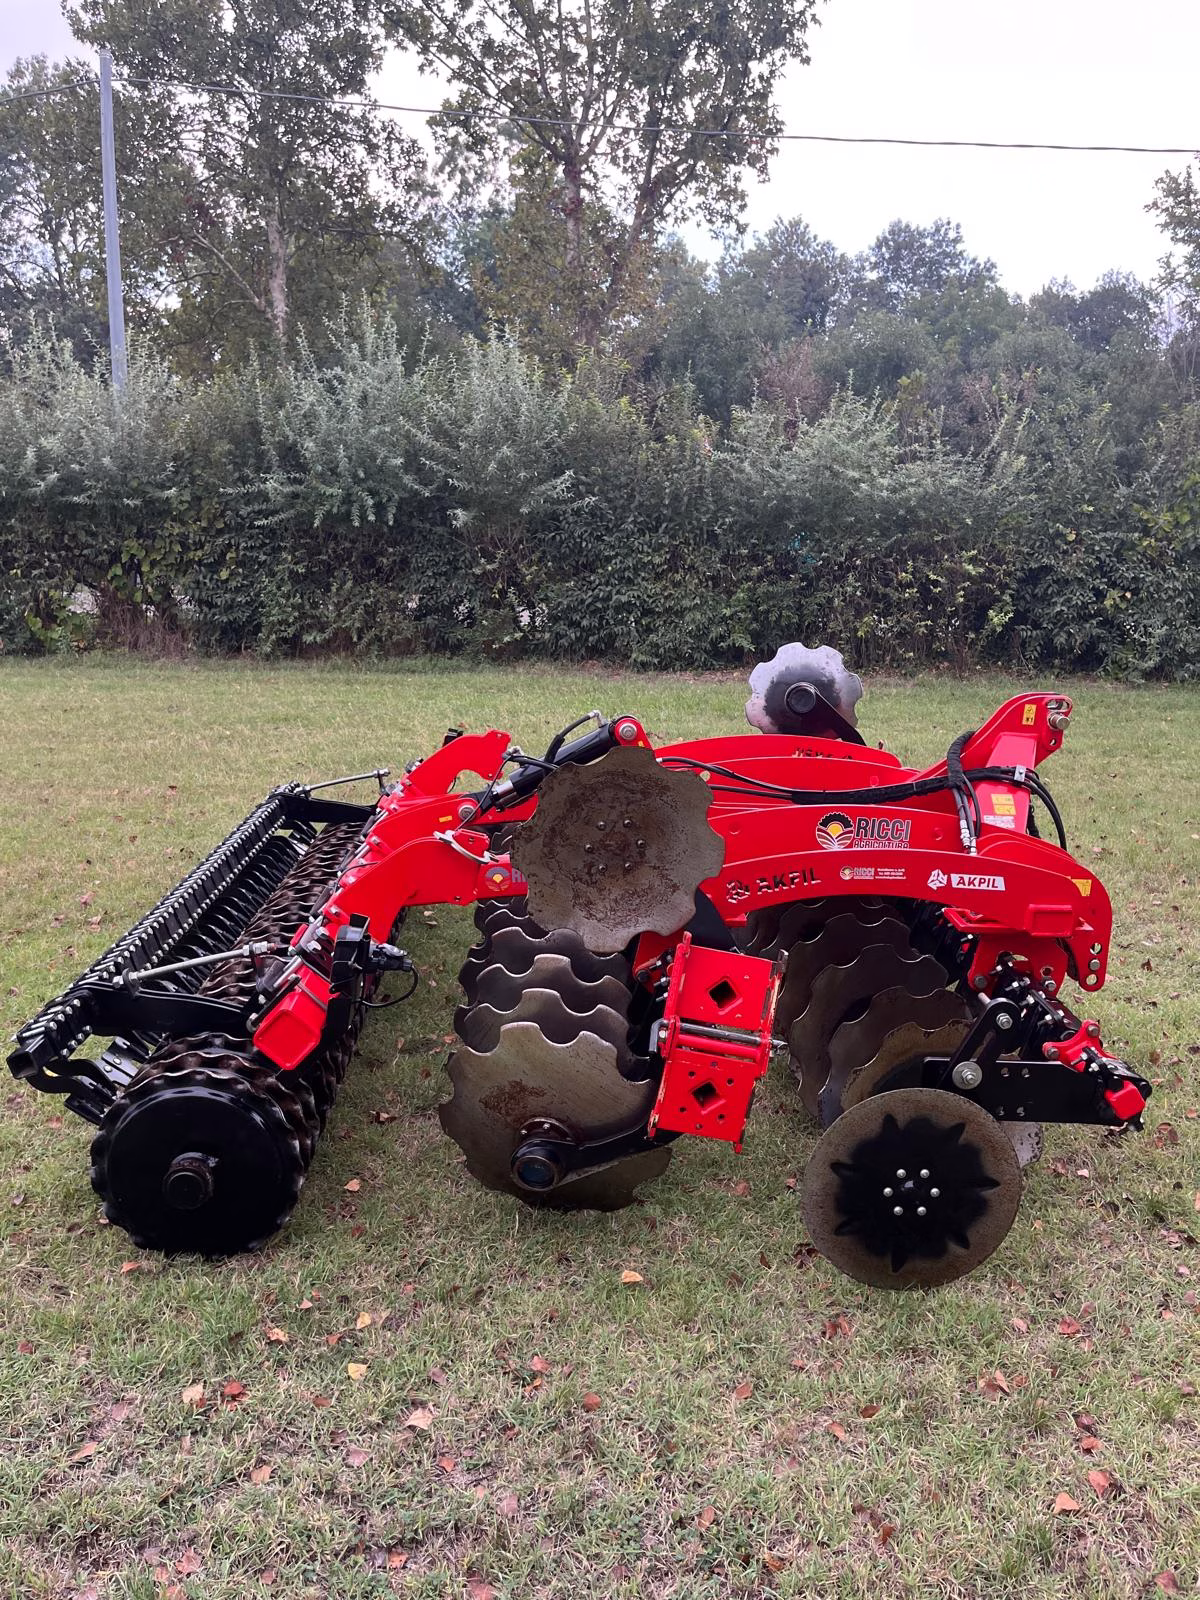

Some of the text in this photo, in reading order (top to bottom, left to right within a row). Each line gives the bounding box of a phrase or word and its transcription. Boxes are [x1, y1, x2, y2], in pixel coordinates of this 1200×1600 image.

[855, 816, 911, 841] RICCI
[756, 867, 822, 895] AKPIL
[956, 876, 999, 889] AKPIL
